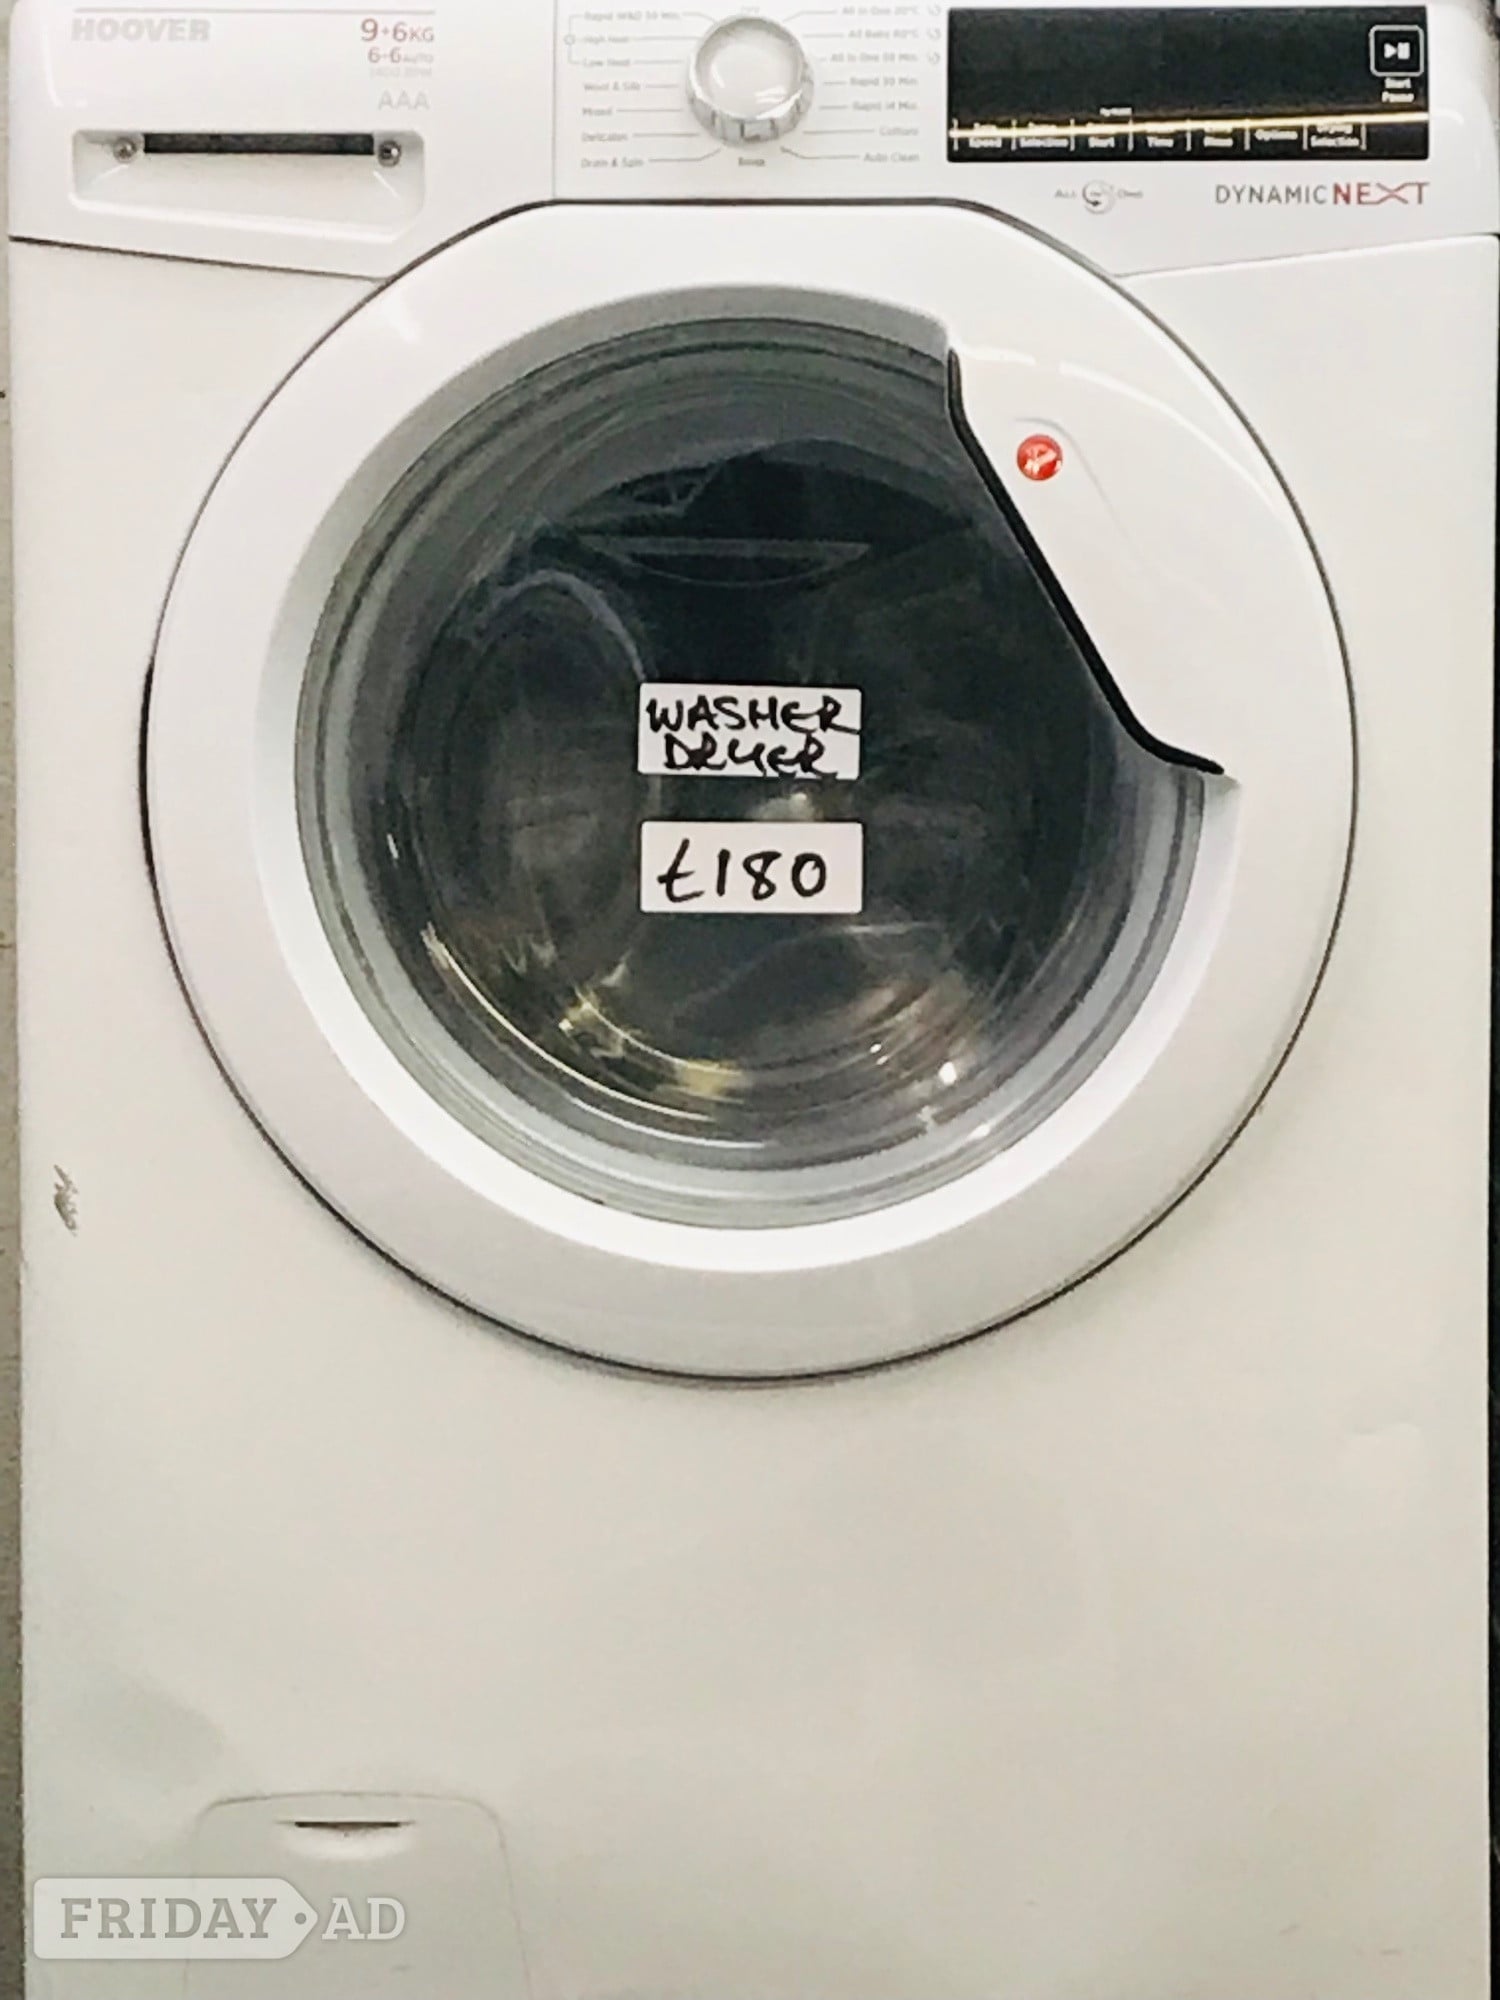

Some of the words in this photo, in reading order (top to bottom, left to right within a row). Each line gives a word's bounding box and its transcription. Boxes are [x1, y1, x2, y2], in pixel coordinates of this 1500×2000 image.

[71, 18, 211, 42] HOOVER
[378, 89, 430, 110] AAA
[1215, 184, 1327, 205] DYNAMIC
[646, 695, 861, 735] WASHER
[656, 838, 828, 902] £180
